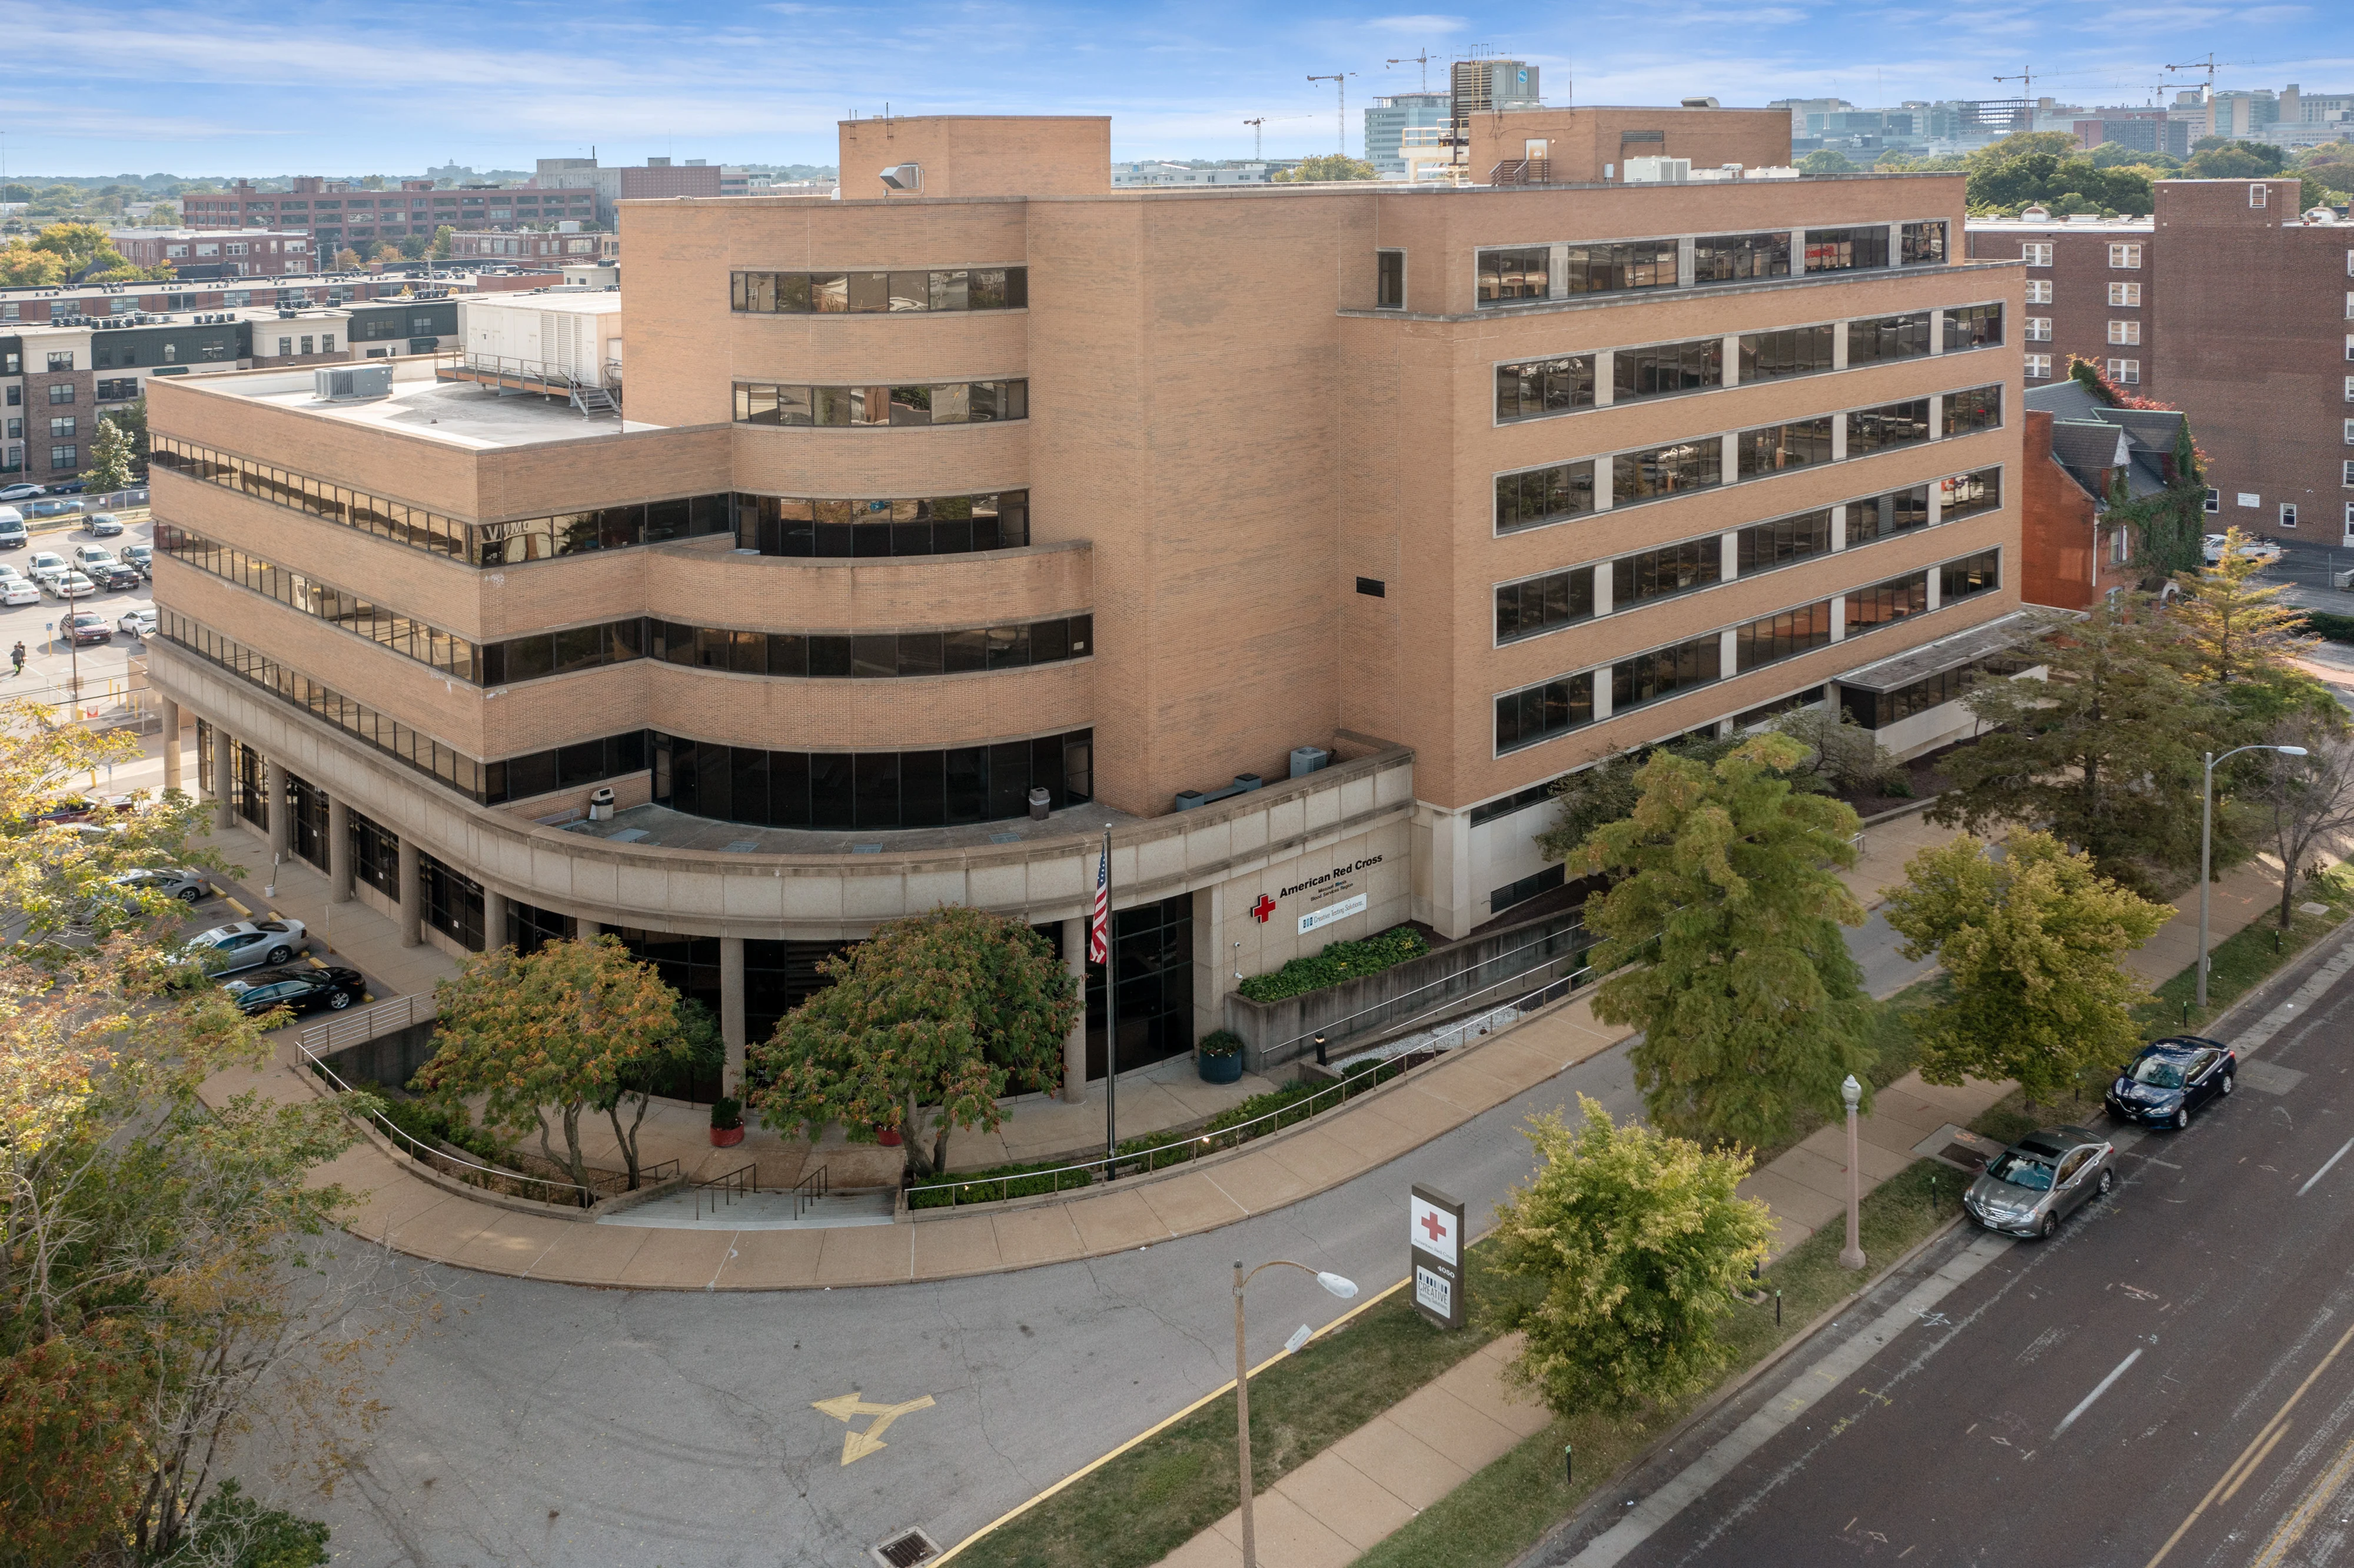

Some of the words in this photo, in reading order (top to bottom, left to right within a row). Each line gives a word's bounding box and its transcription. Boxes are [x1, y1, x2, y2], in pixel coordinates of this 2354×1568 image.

[1279, 873, 1331, 898] American
[1333, 863, 1352, 878] Red
[1355, 855, 1383, 870] Cross
[1311, 893, 1322, 901] Blood
[1322, 888, 1339, 897] Services
[1314, 913, 1331, 923] Creative
[1331, 908, 1345, 917] Testing
[1437, 1266, 1455, 1279] 4050
[1418, 1281, 1448, 1305] CREATIVE
